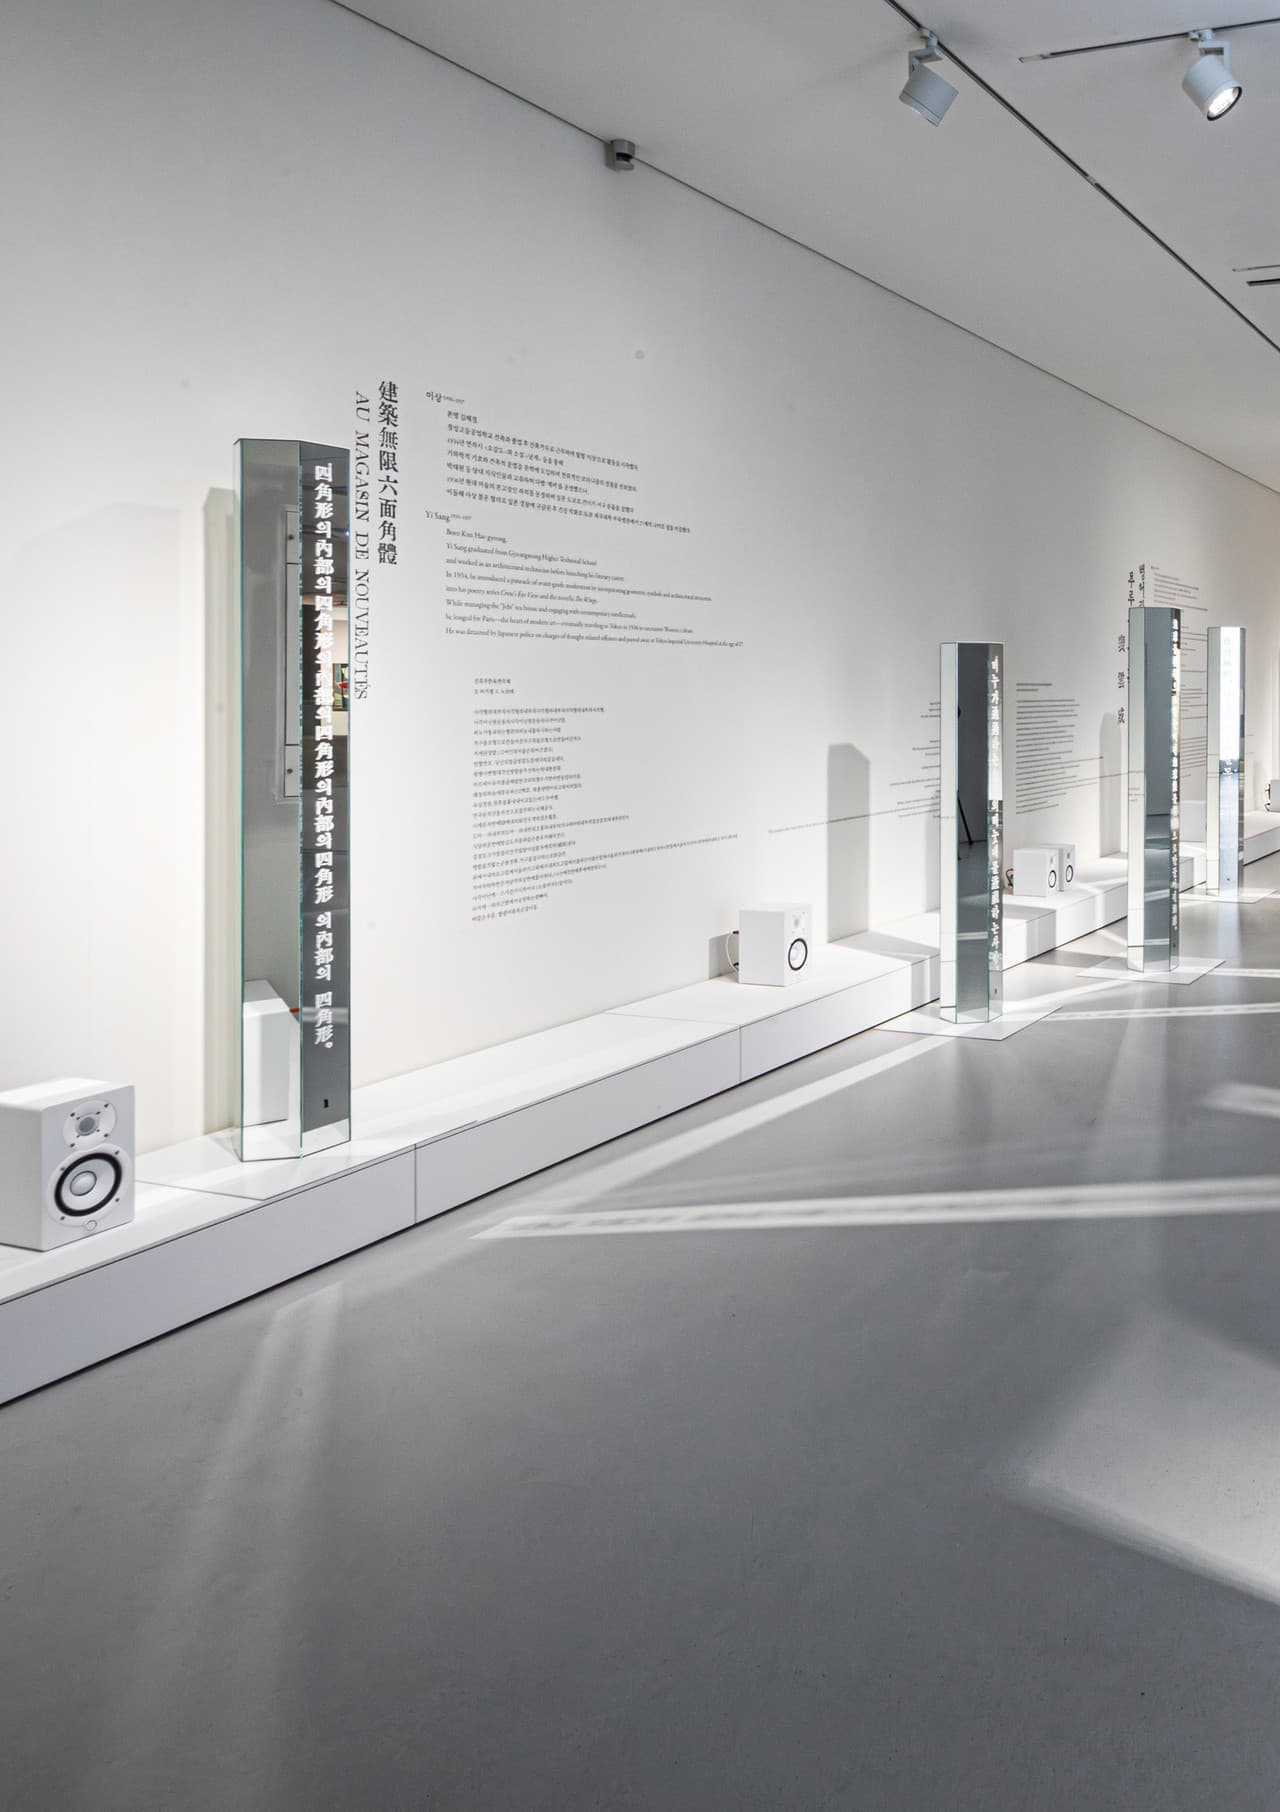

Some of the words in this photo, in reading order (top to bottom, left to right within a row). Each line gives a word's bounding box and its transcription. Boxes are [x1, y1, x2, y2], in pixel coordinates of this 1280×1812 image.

[356, 392, 369, 421] AU
[356, 432, 369, 521] MAGASIN
[377, 381, 399, 565] 建築無限六面角體
[425, 510, 434, 519] Yi
[434, 512, 451, 523] Sang
[356, 534, 368, 559] DE
[355, 570, 371, 700] NOUVEAUTÉS
